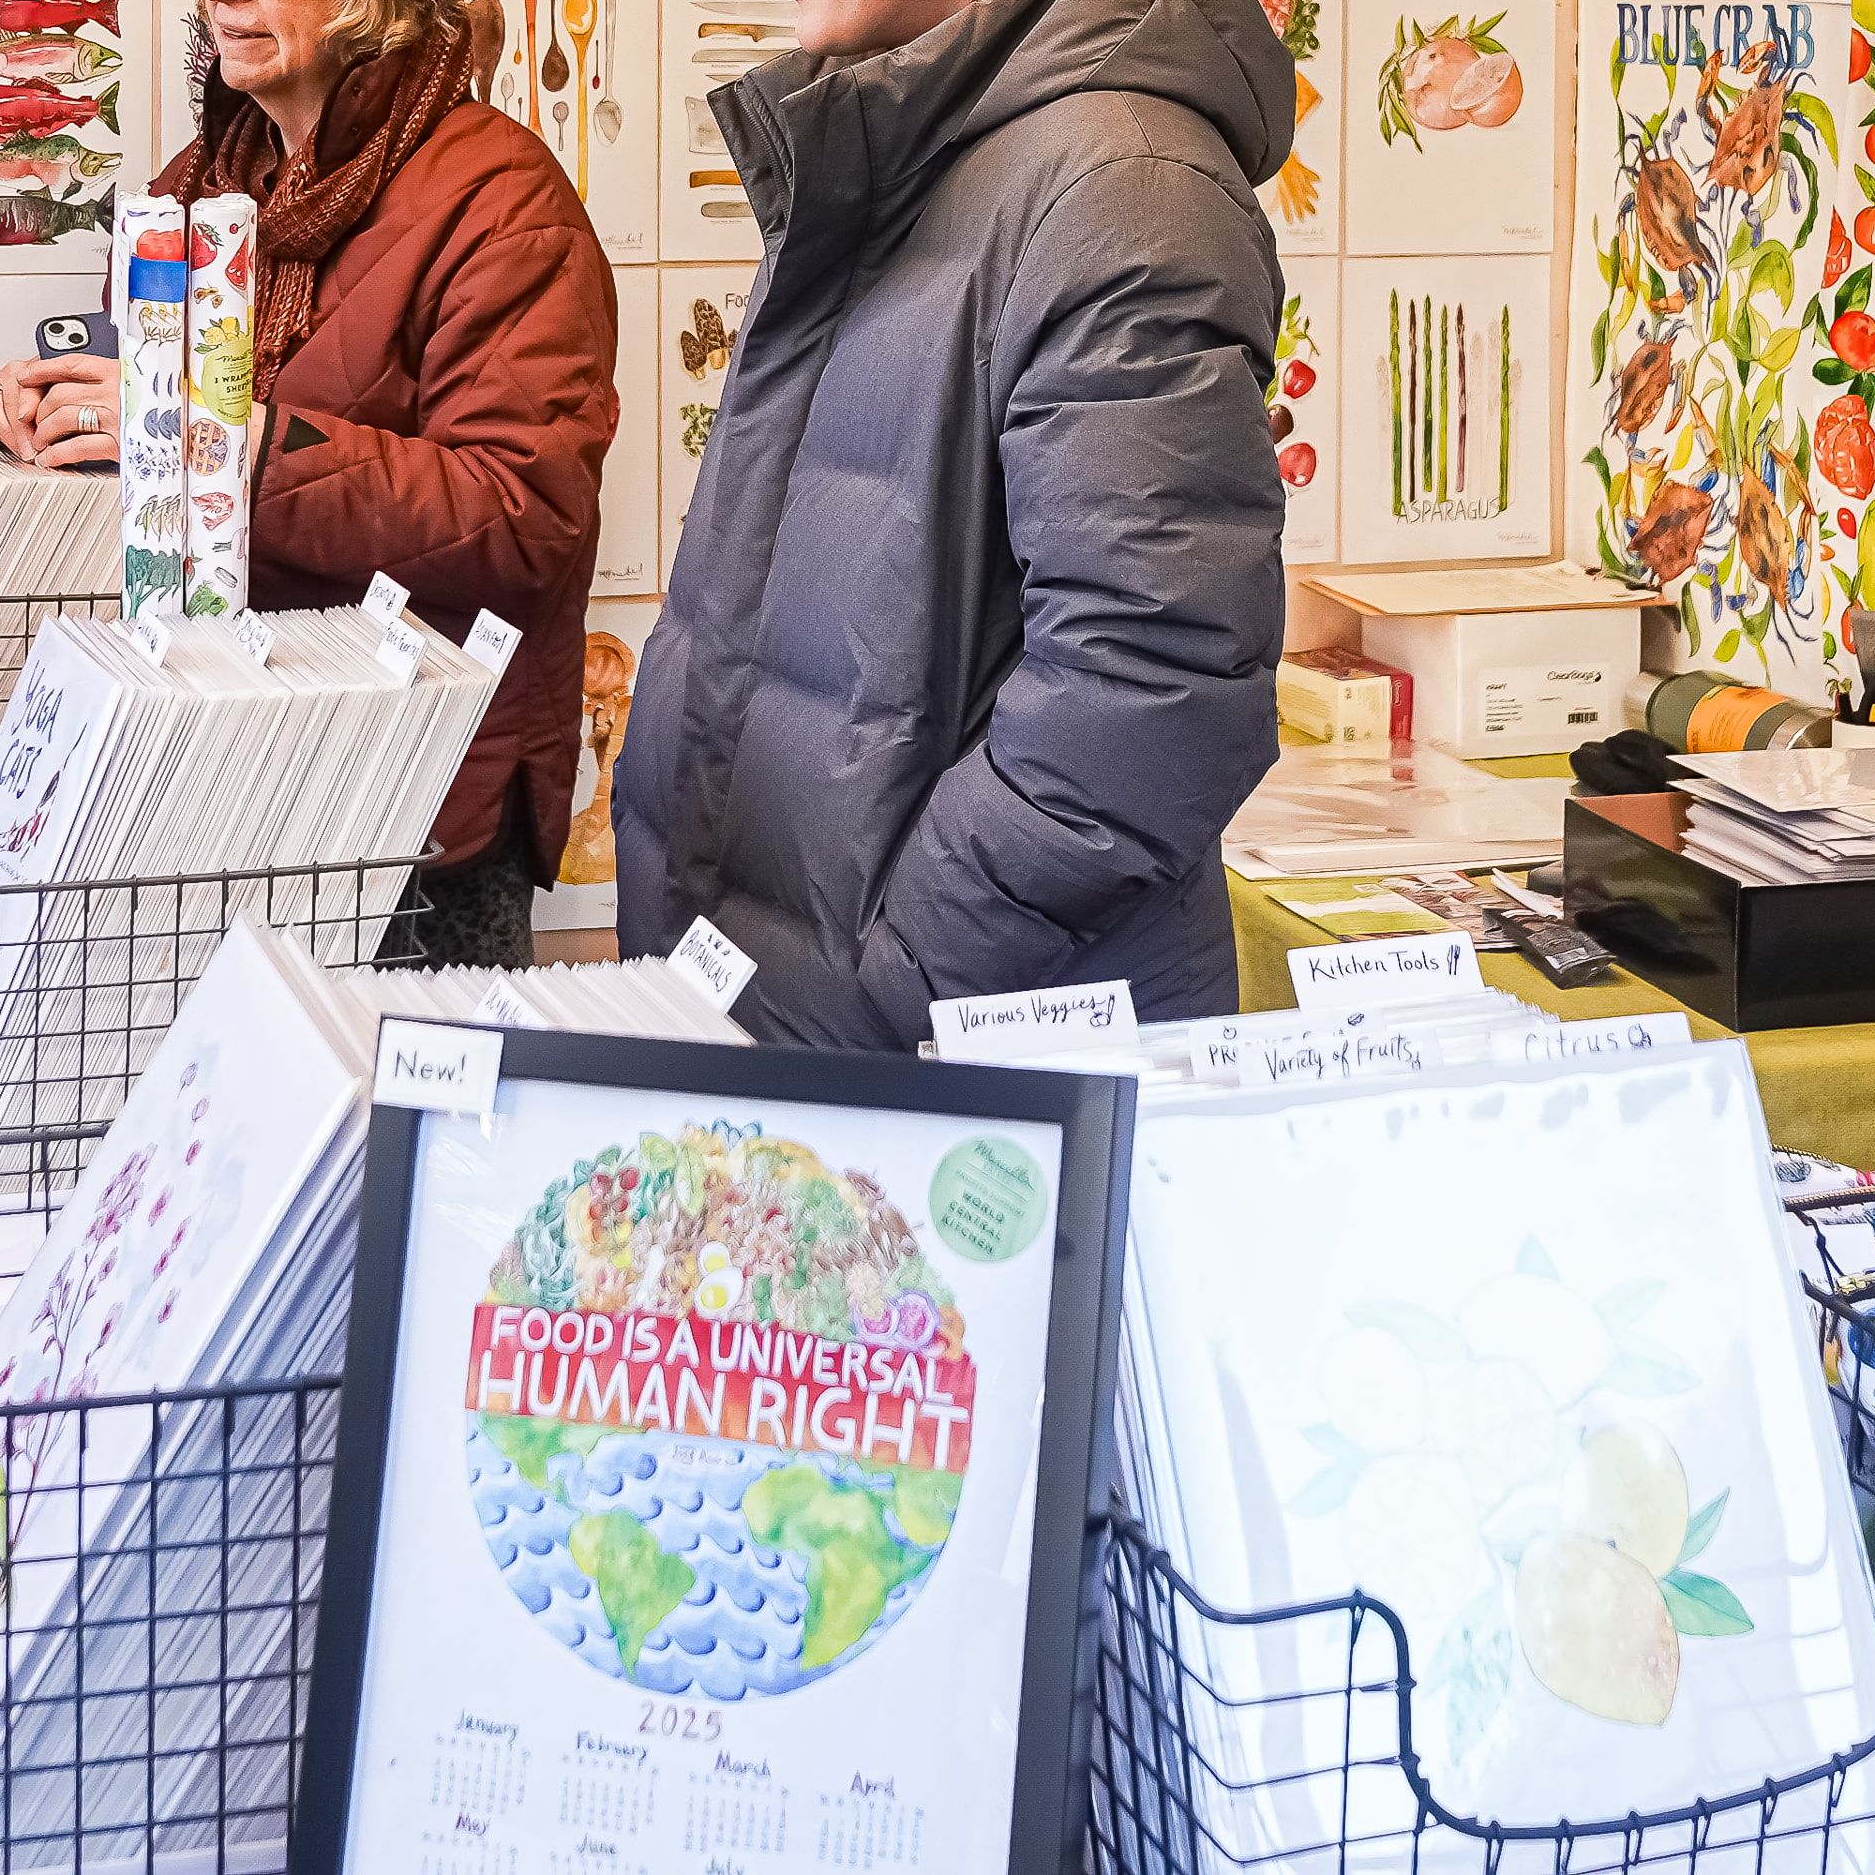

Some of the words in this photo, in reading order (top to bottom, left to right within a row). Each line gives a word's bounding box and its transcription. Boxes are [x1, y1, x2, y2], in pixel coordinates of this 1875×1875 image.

[1616, 2, 1706, 69] BLUE
[1396, 500, 1502, 524] ASPARAGUS
[1309, 952, 1381, 978] Kitchen
[1387, 949, 1439, 973] Tools
[957, 1002, 1026, 1034] Various
[1031, 992, 1102, 1028] Veggies
[392, 1050, 468, 1084] New!
[1263, 1045, 1324, 1080] Variety
[1328, 1037, 1349, 1069] of
[1354, 1031, 1414, 1067] Fruits
[489, 1306, 614, 1356] FOOD
[621, 1314, 660, 1359] IS
[664, 1318, 700, 1366] A
[709, 1321, 957, 1405] UNIVERSAL
[477, 1349, 723, 1436] HUMAN
[748, 1376, 968, 1473] RIGHT
[637, 1701, 725, 1742] 2025
[715, 1751, 773, 1780] March
